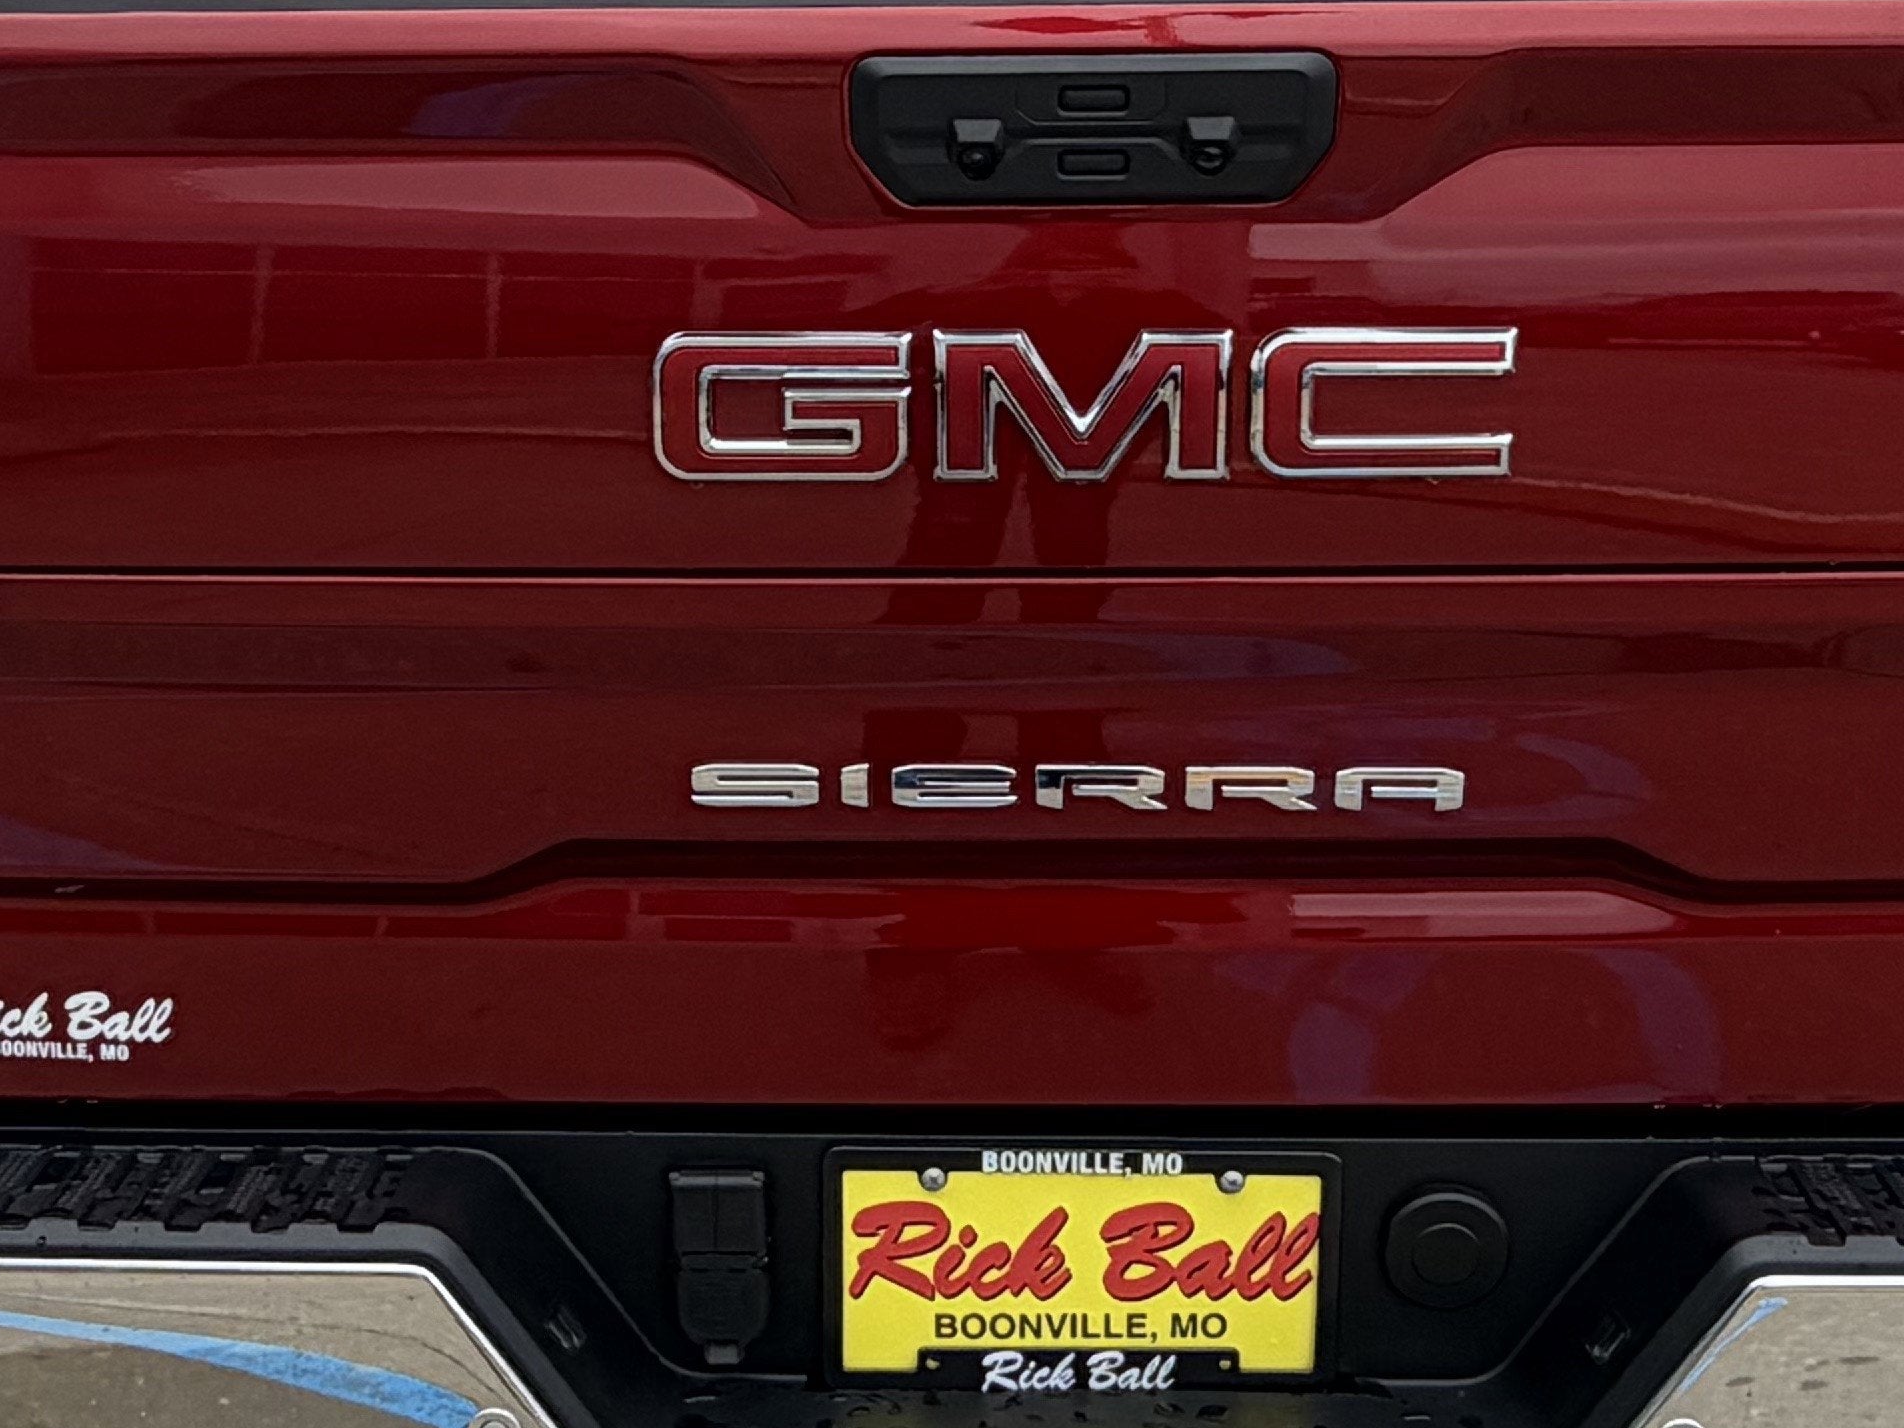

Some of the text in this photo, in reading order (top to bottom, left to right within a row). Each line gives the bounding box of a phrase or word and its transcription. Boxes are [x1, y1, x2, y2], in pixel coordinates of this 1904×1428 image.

[652, 327, 1519, 482] GMC
[690, 762, 1466, 812] SIERRA
[64, 990, 174, 1043] Ball
[100, 1043, 130, 1062] MO
[981, 1150, 1184, 1178] BOONVILLE, MO
[848, 1200, 1320, 1302] Rick Ball
[934, 1312, 1228, 1344] BOONVILLE, MO
[981, 1350, 1176, 1394] Rick Ball
